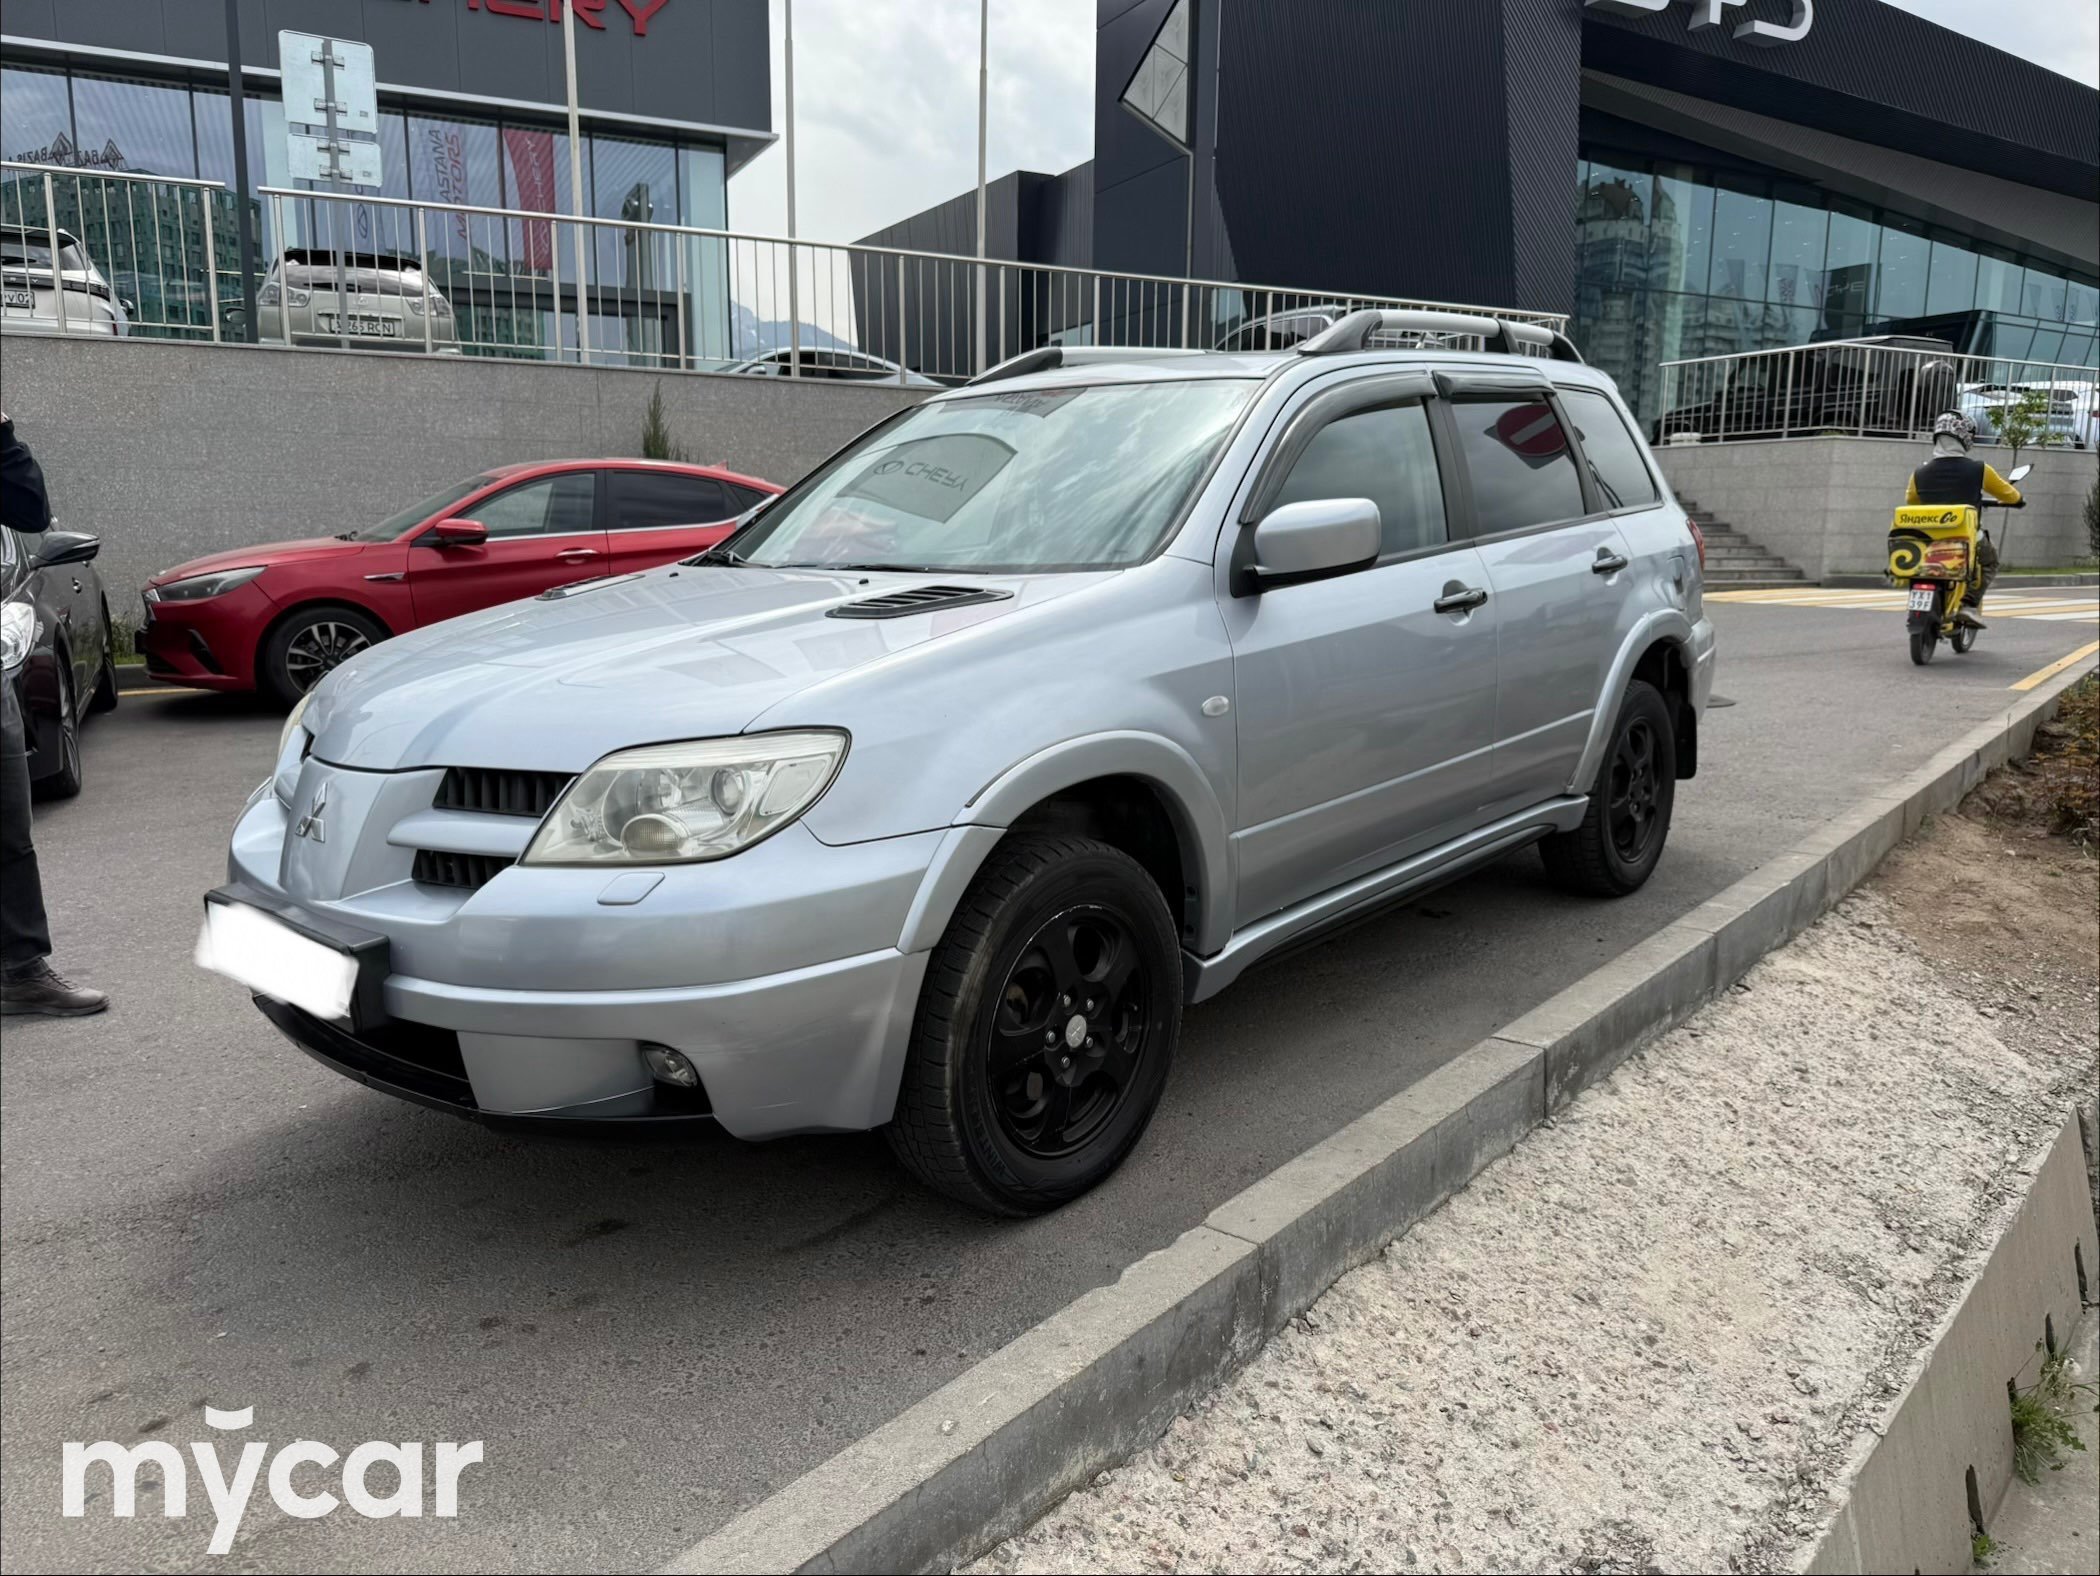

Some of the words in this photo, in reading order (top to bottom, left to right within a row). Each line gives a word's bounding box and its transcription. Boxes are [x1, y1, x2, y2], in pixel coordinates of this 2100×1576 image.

[428, 129, 451, 203] ASTANA
[1900, 513, 1940, 524] Яндекс
[1939, 511, 1958, 524] Go
